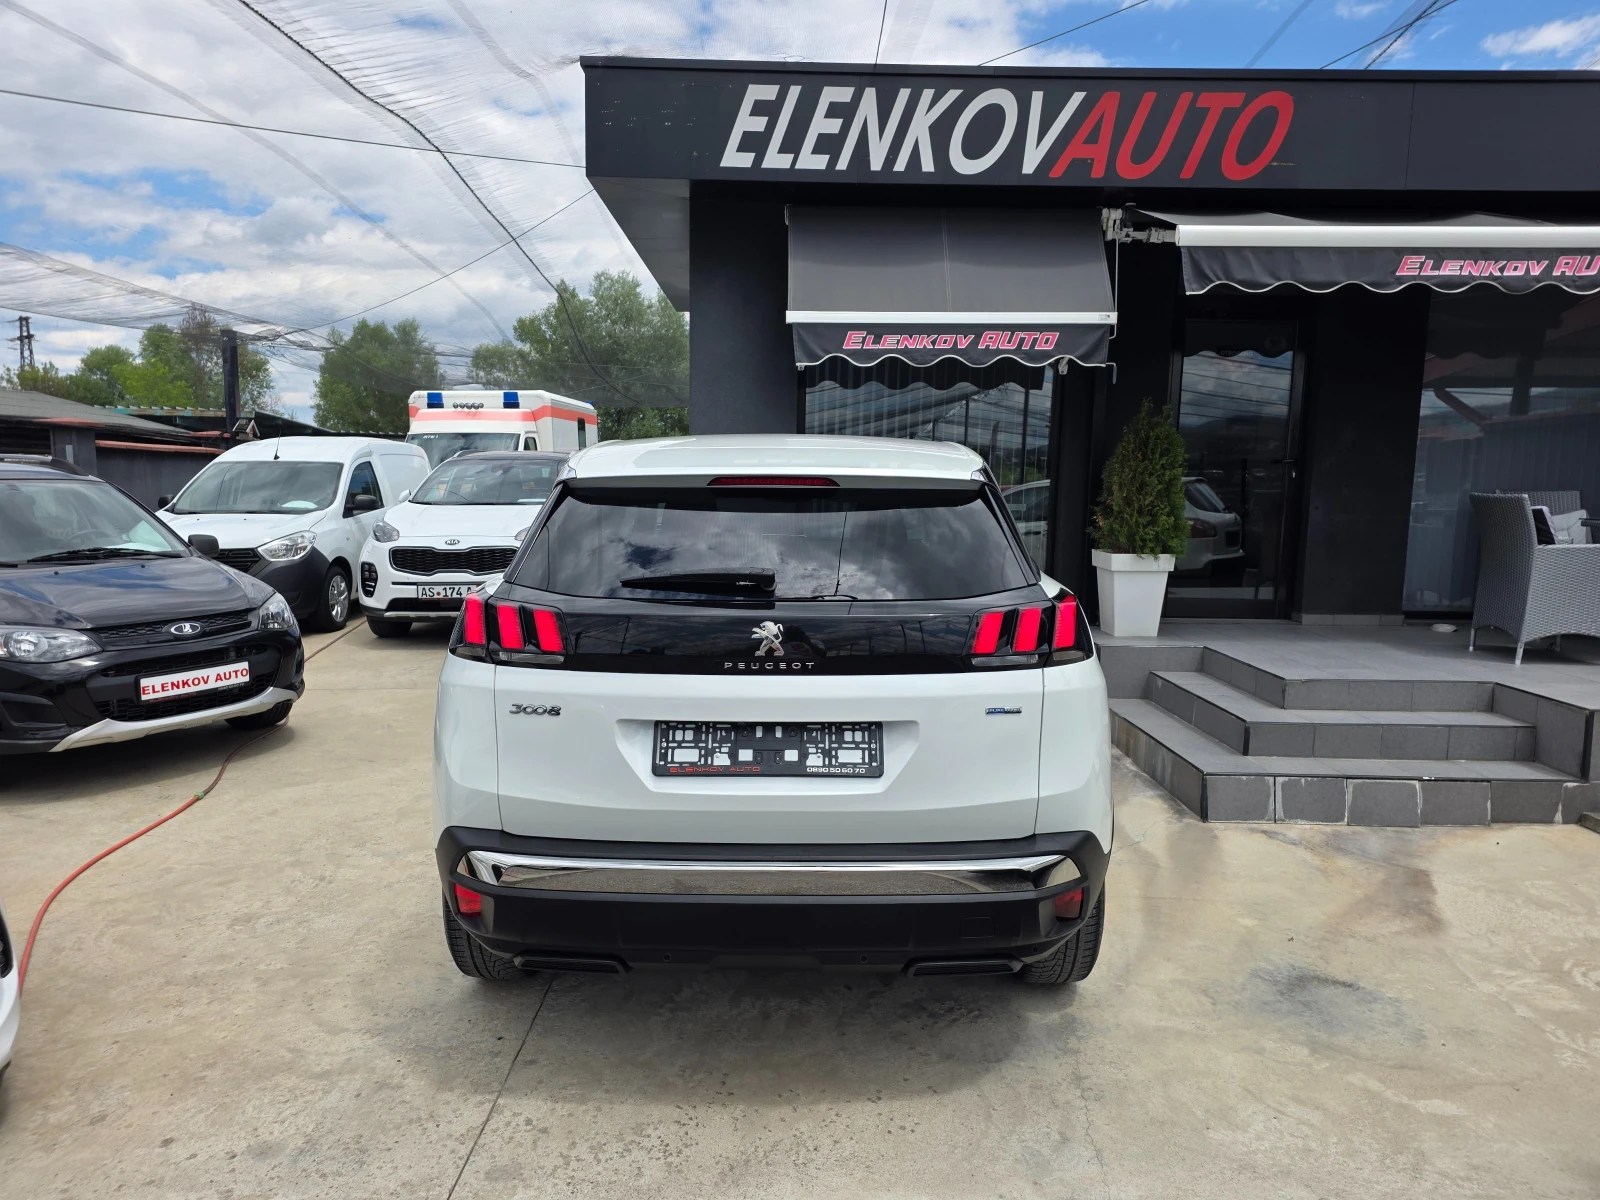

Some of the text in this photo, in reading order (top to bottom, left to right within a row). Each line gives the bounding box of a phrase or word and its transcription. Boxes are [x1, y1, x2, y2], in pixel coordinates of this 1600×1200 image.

[1396, 255, 1549, 276] ELENKOV
[843, 331, 1060, 350] ELENKOV AUTO
[421, 586, 435, 598] AS
[442, 586, 463, 597] 174
[141, 674, 211, 695] ELENKOV
[214, 668, 249, 683] AUTO
[509, 703, 562, 716] 3008
